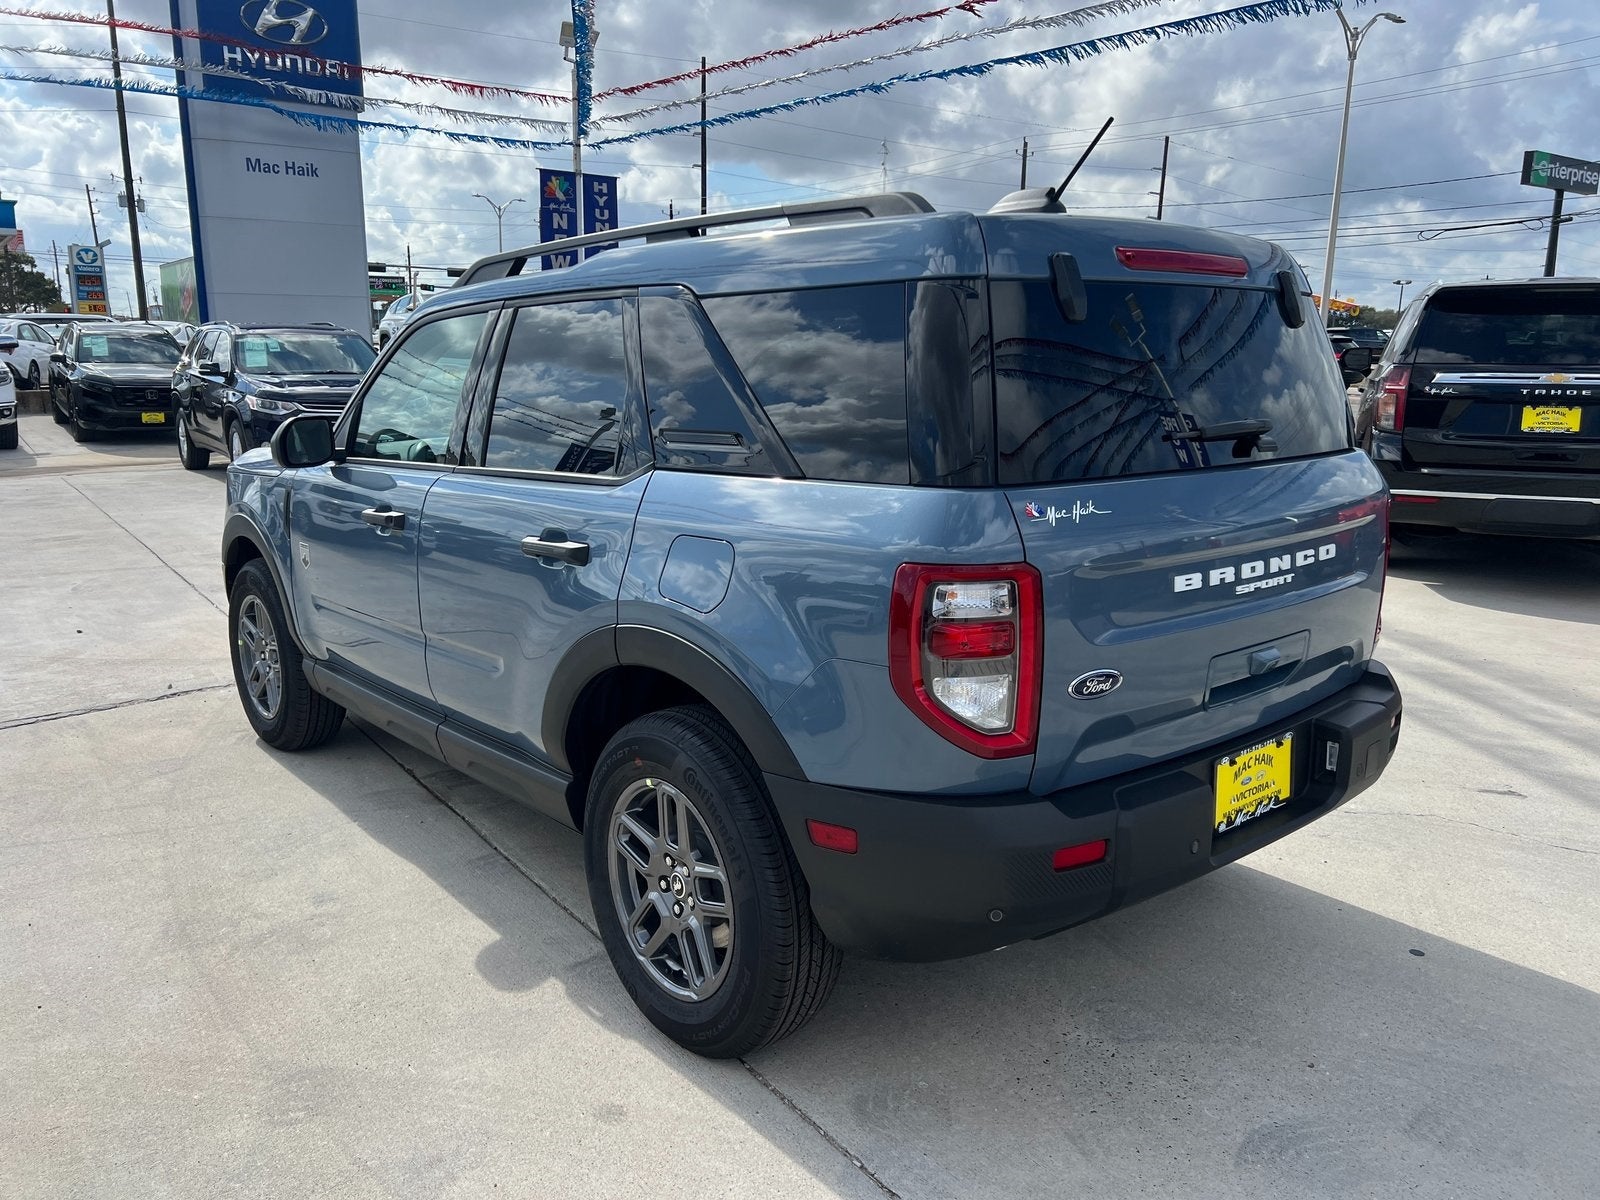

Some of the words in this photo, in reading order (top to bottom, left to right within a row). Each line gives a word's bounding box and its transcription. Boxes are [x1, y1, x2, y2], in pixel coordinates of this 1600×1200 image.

[222, 45, 349, 80] HYUNDAI
[245, 157, 281, 174] Mac
[284, 160, 319, 178] Haik
[1531, 160, 1599, 186] enterprise
[1520, 388, 1592, 396] TAHOE
[1535, 409, 1551, 418] MAC
[1550, 409, 1567, 418] HAIK
[1034, 506, 1072, 527] Mac
[1072, 499, 1113, 524] Haik
[1173, 543, 1337, 593] BRONCO
[1235, 573, 1296, 595] SPORT
[1082, 675, 1113, 695] Ford
[1233, 756, 1254, 784] MAC
[1253, 753, 1275, 769] HAIK
[1235, 780, 1271, 802] VICTORIA
[683, 766, 738, 860] Continental
[1254, 797, 1287, 818] Haik
